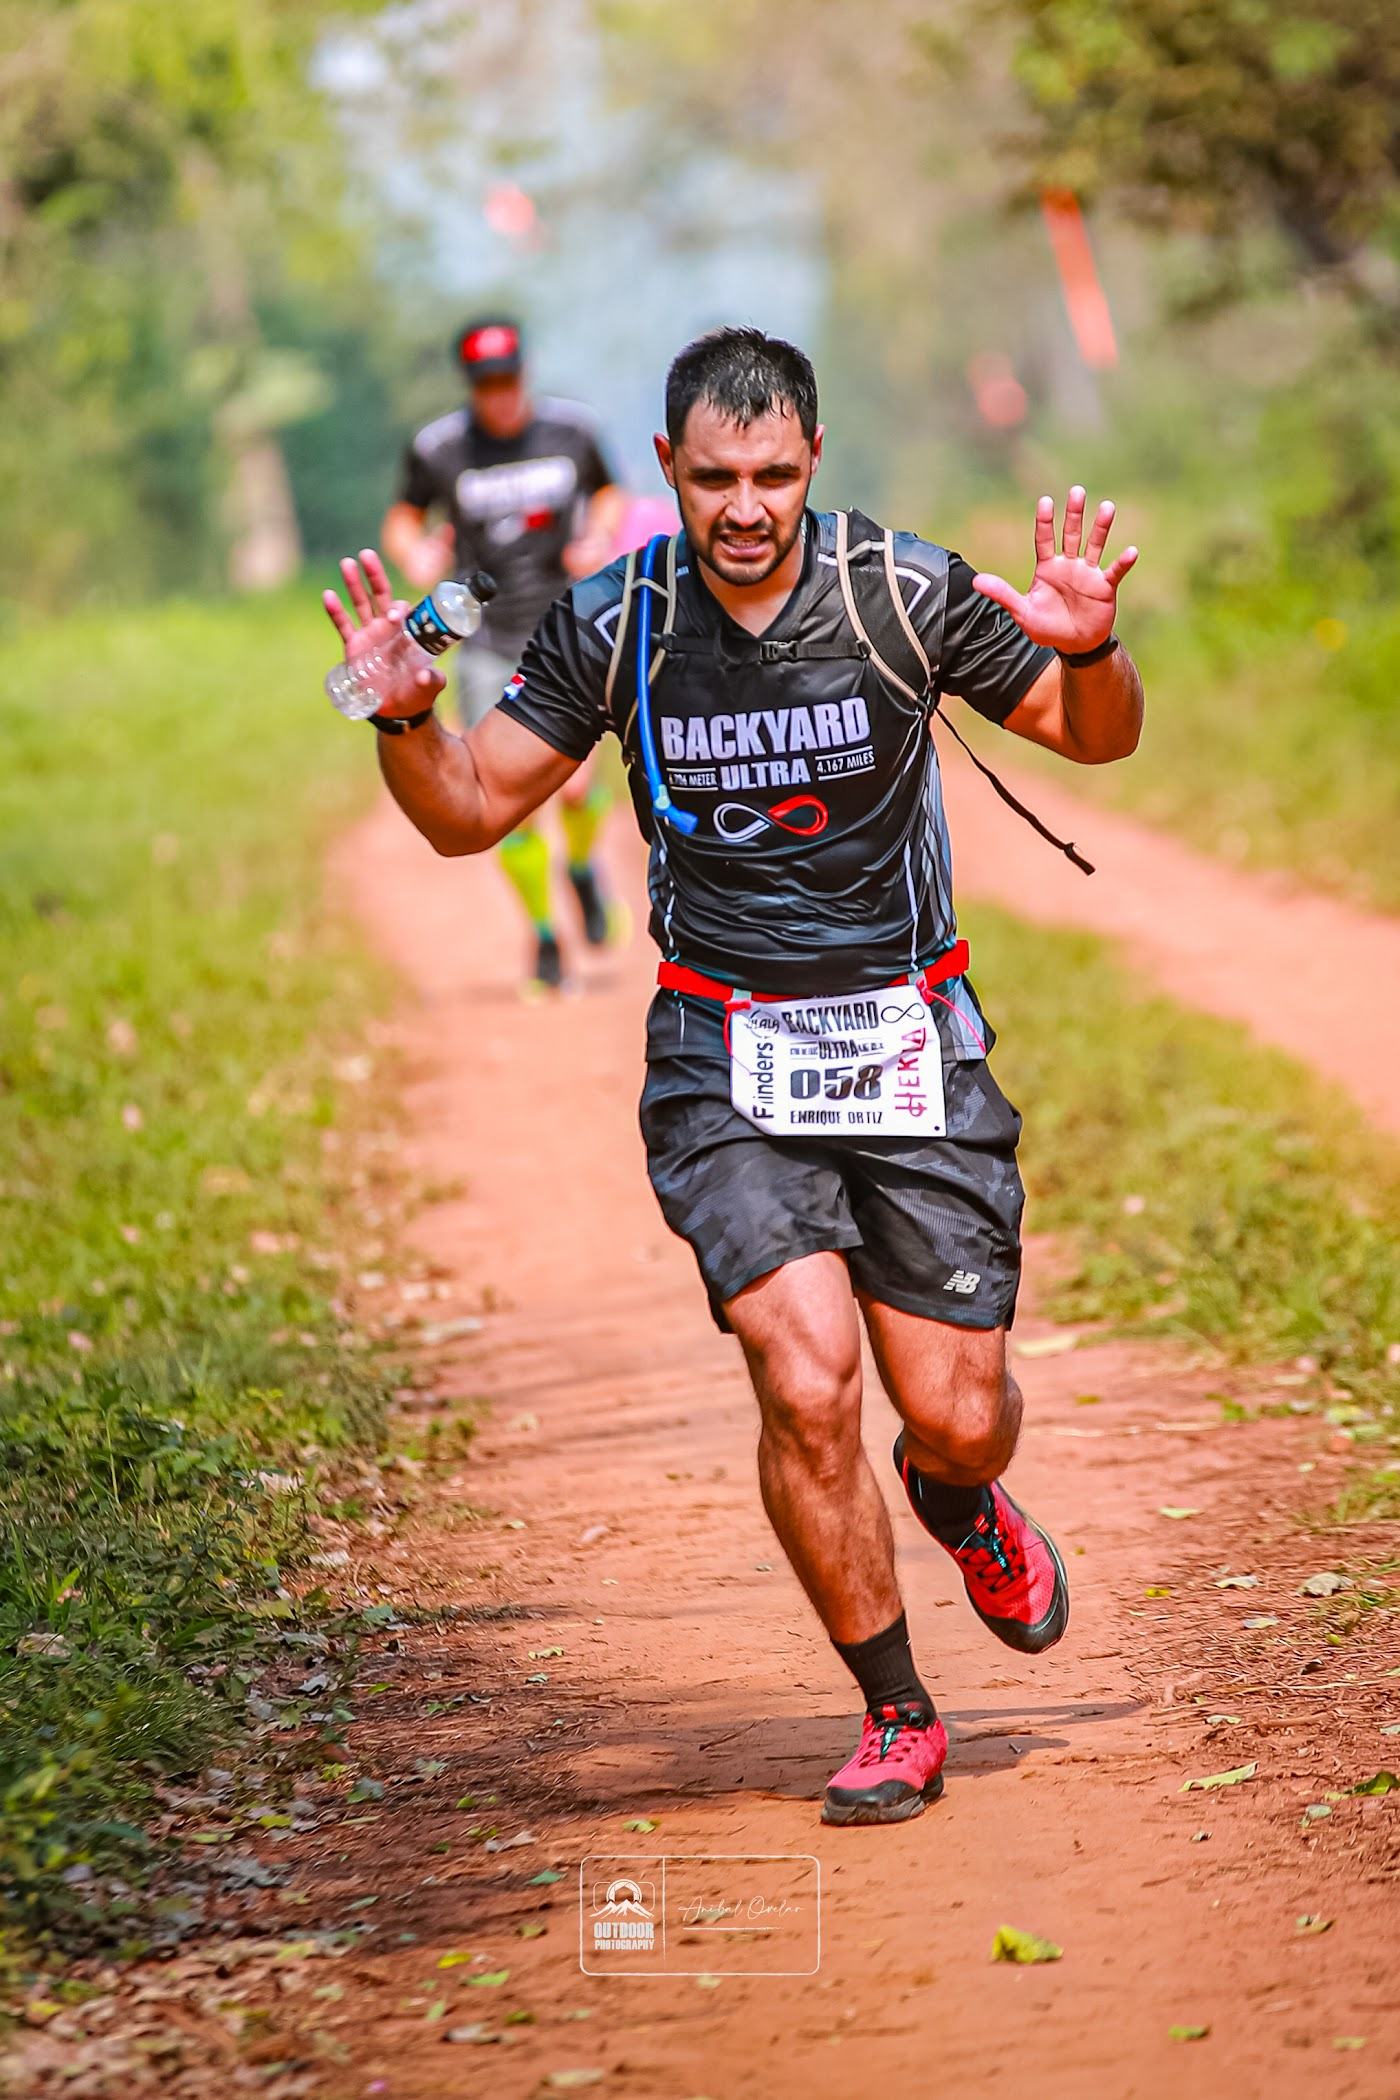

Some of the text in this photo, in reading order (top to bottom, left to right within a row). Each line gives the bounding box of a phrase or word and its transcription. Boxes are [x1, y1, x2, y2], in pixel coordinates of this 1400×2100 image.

[660, 696, 871, 761] BACKYARD
[720, 757, 811, 791] ULTRA
[816, 749, 876, 774] 4.167 MILES
[781, 1000, 880, 1036] BACKYARD
[818, 1039, 859, 1060] ULTRA
[790, 1064, 883, 1101] 058
[790, 1110, 883, 1125] ENRIQUE ORTIZ
